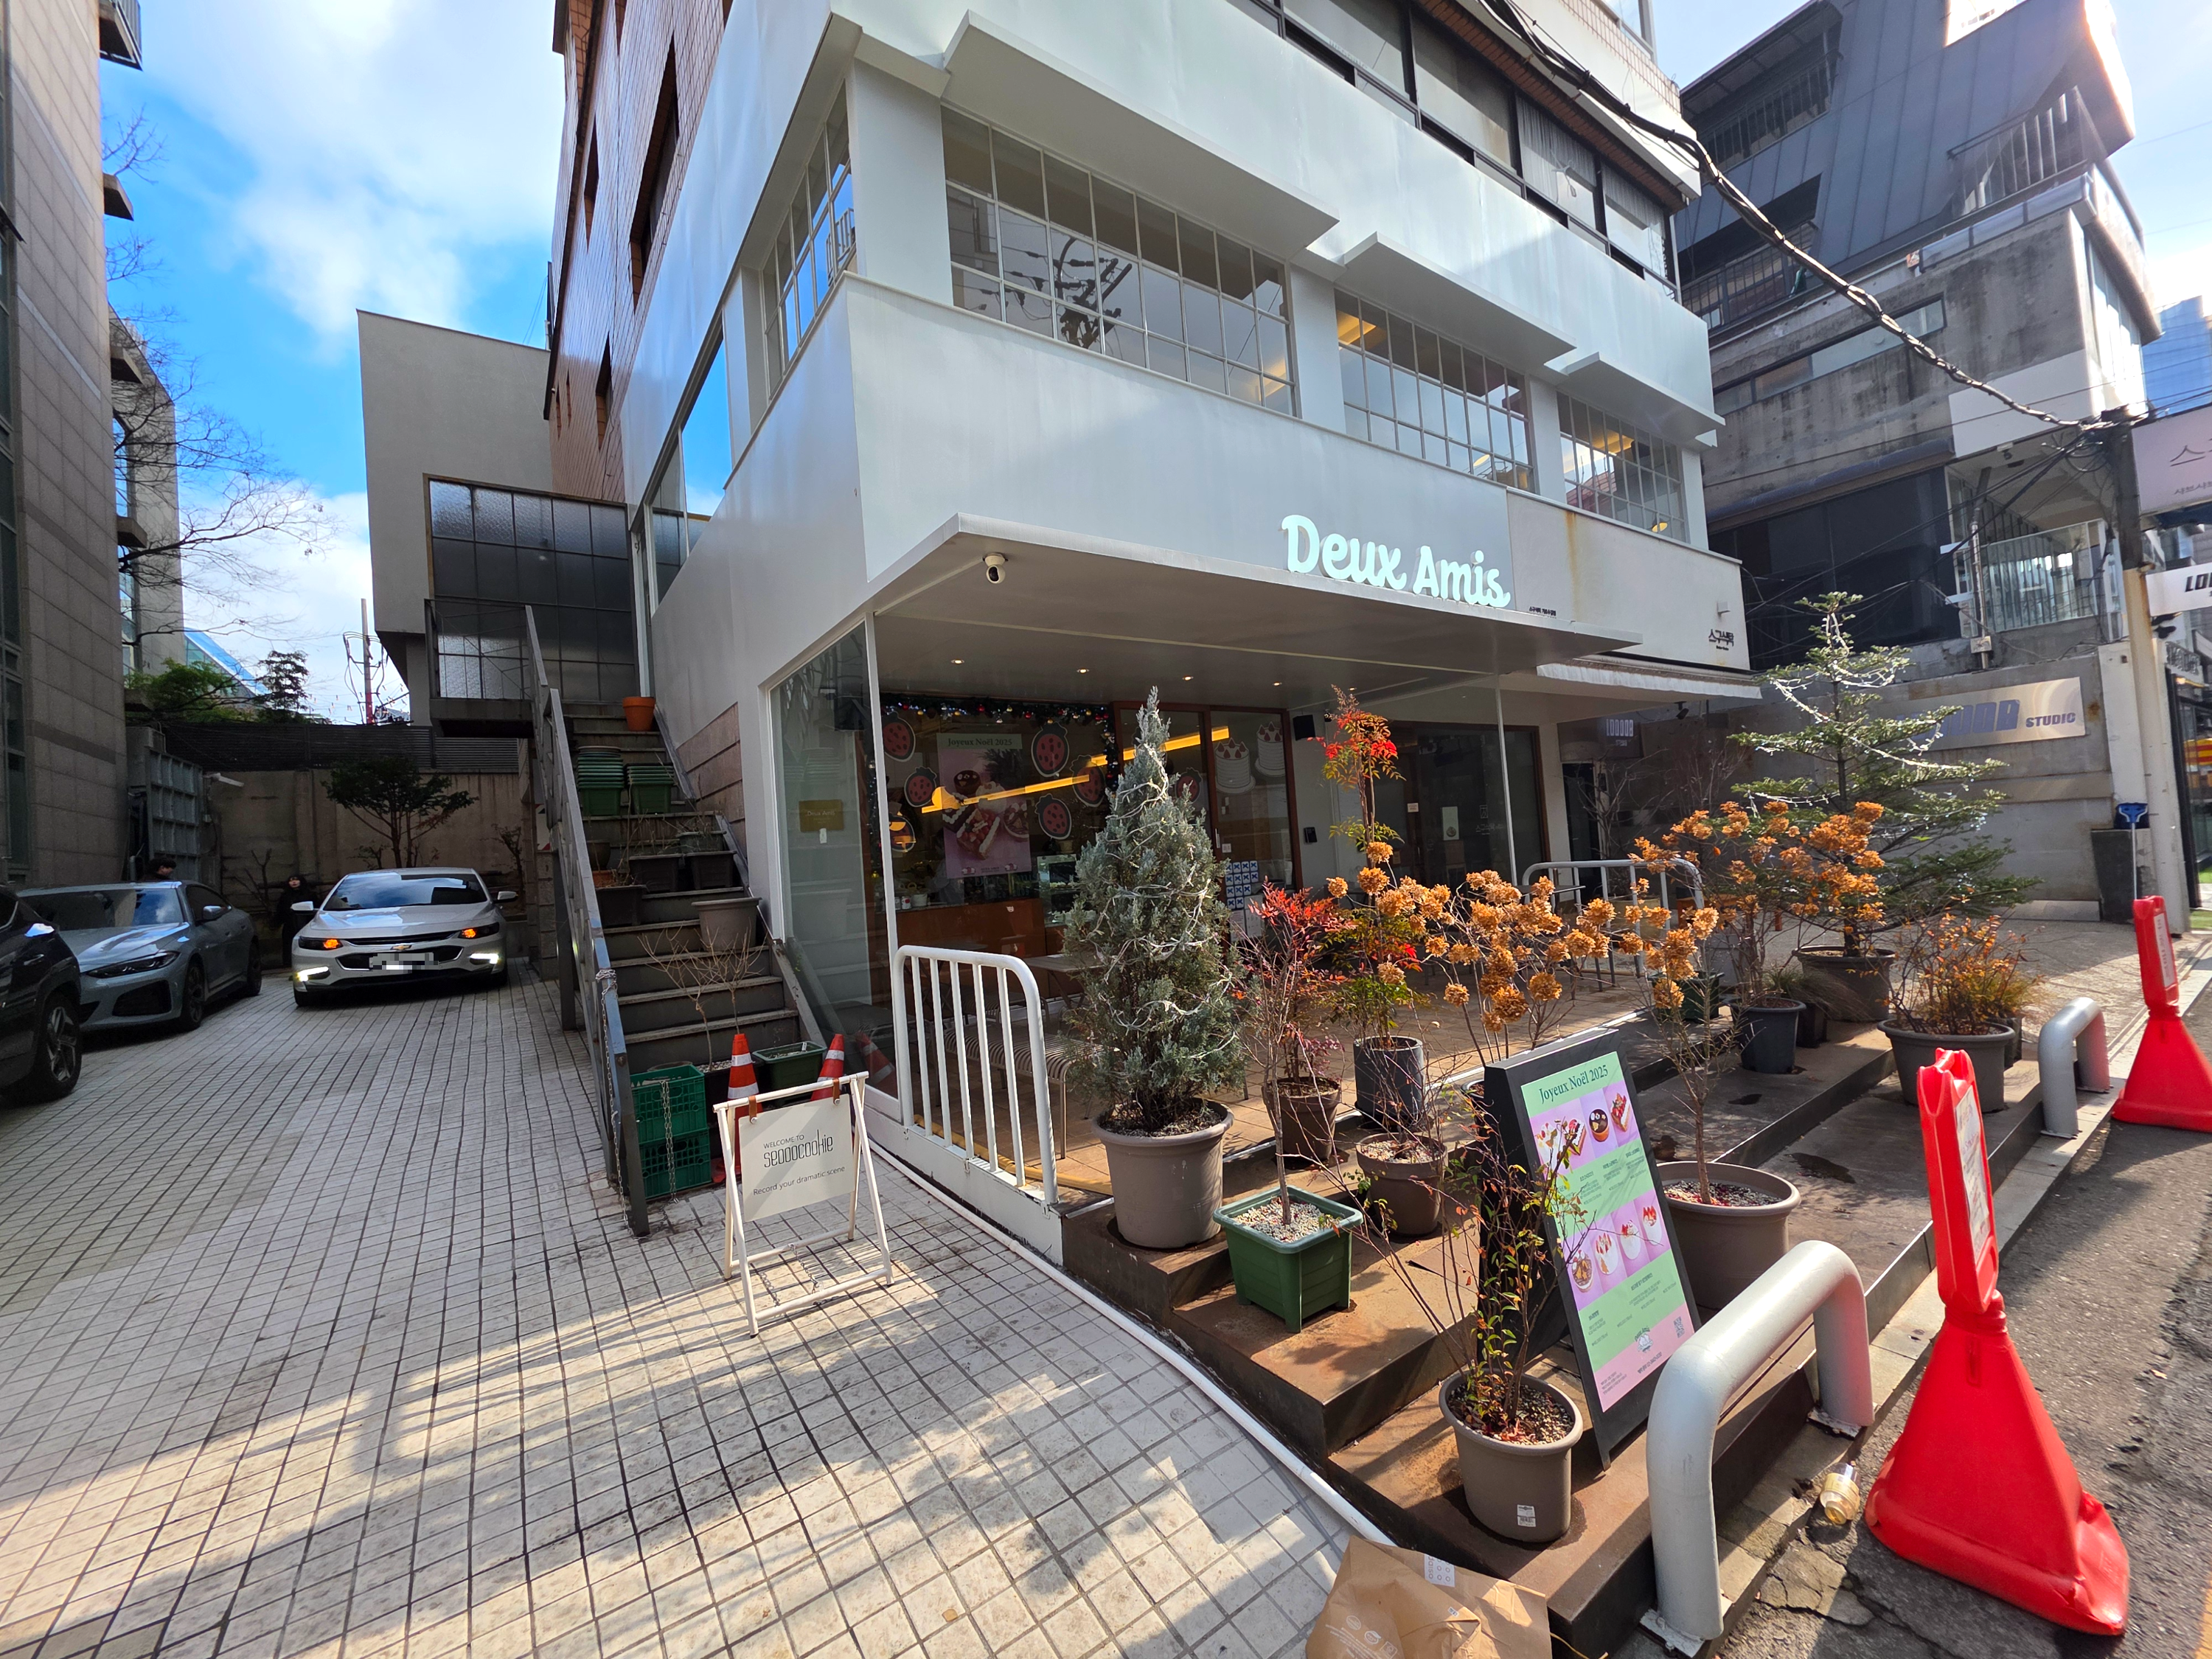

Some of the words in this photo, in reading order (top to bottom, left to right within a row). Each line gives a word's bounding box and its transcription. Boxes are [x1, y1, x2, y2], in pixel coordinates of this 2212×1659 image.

[2170, 437, 2212, 467] 스
[1281, 514, 1407, 591] Deux
[1411, 545, 1511, 608] Amis
[2185, 572, 2212, 592] LO
[948, 738, 974, 747] Joyeux
[1539, 1082, 1569, 1105] Joyeux
[1568, 1071, 1589, 1090] Noël
[1590, 1065, 1608, 1082] 2025
[763, 1136, 795, 1149] WELCOME
[753, 1183, 777, 1195] Record
[779, 1179, 795, 1191] your
[796, 1171, 826, 1183] dramatic
[827, 1166, 845, 1175] scene
